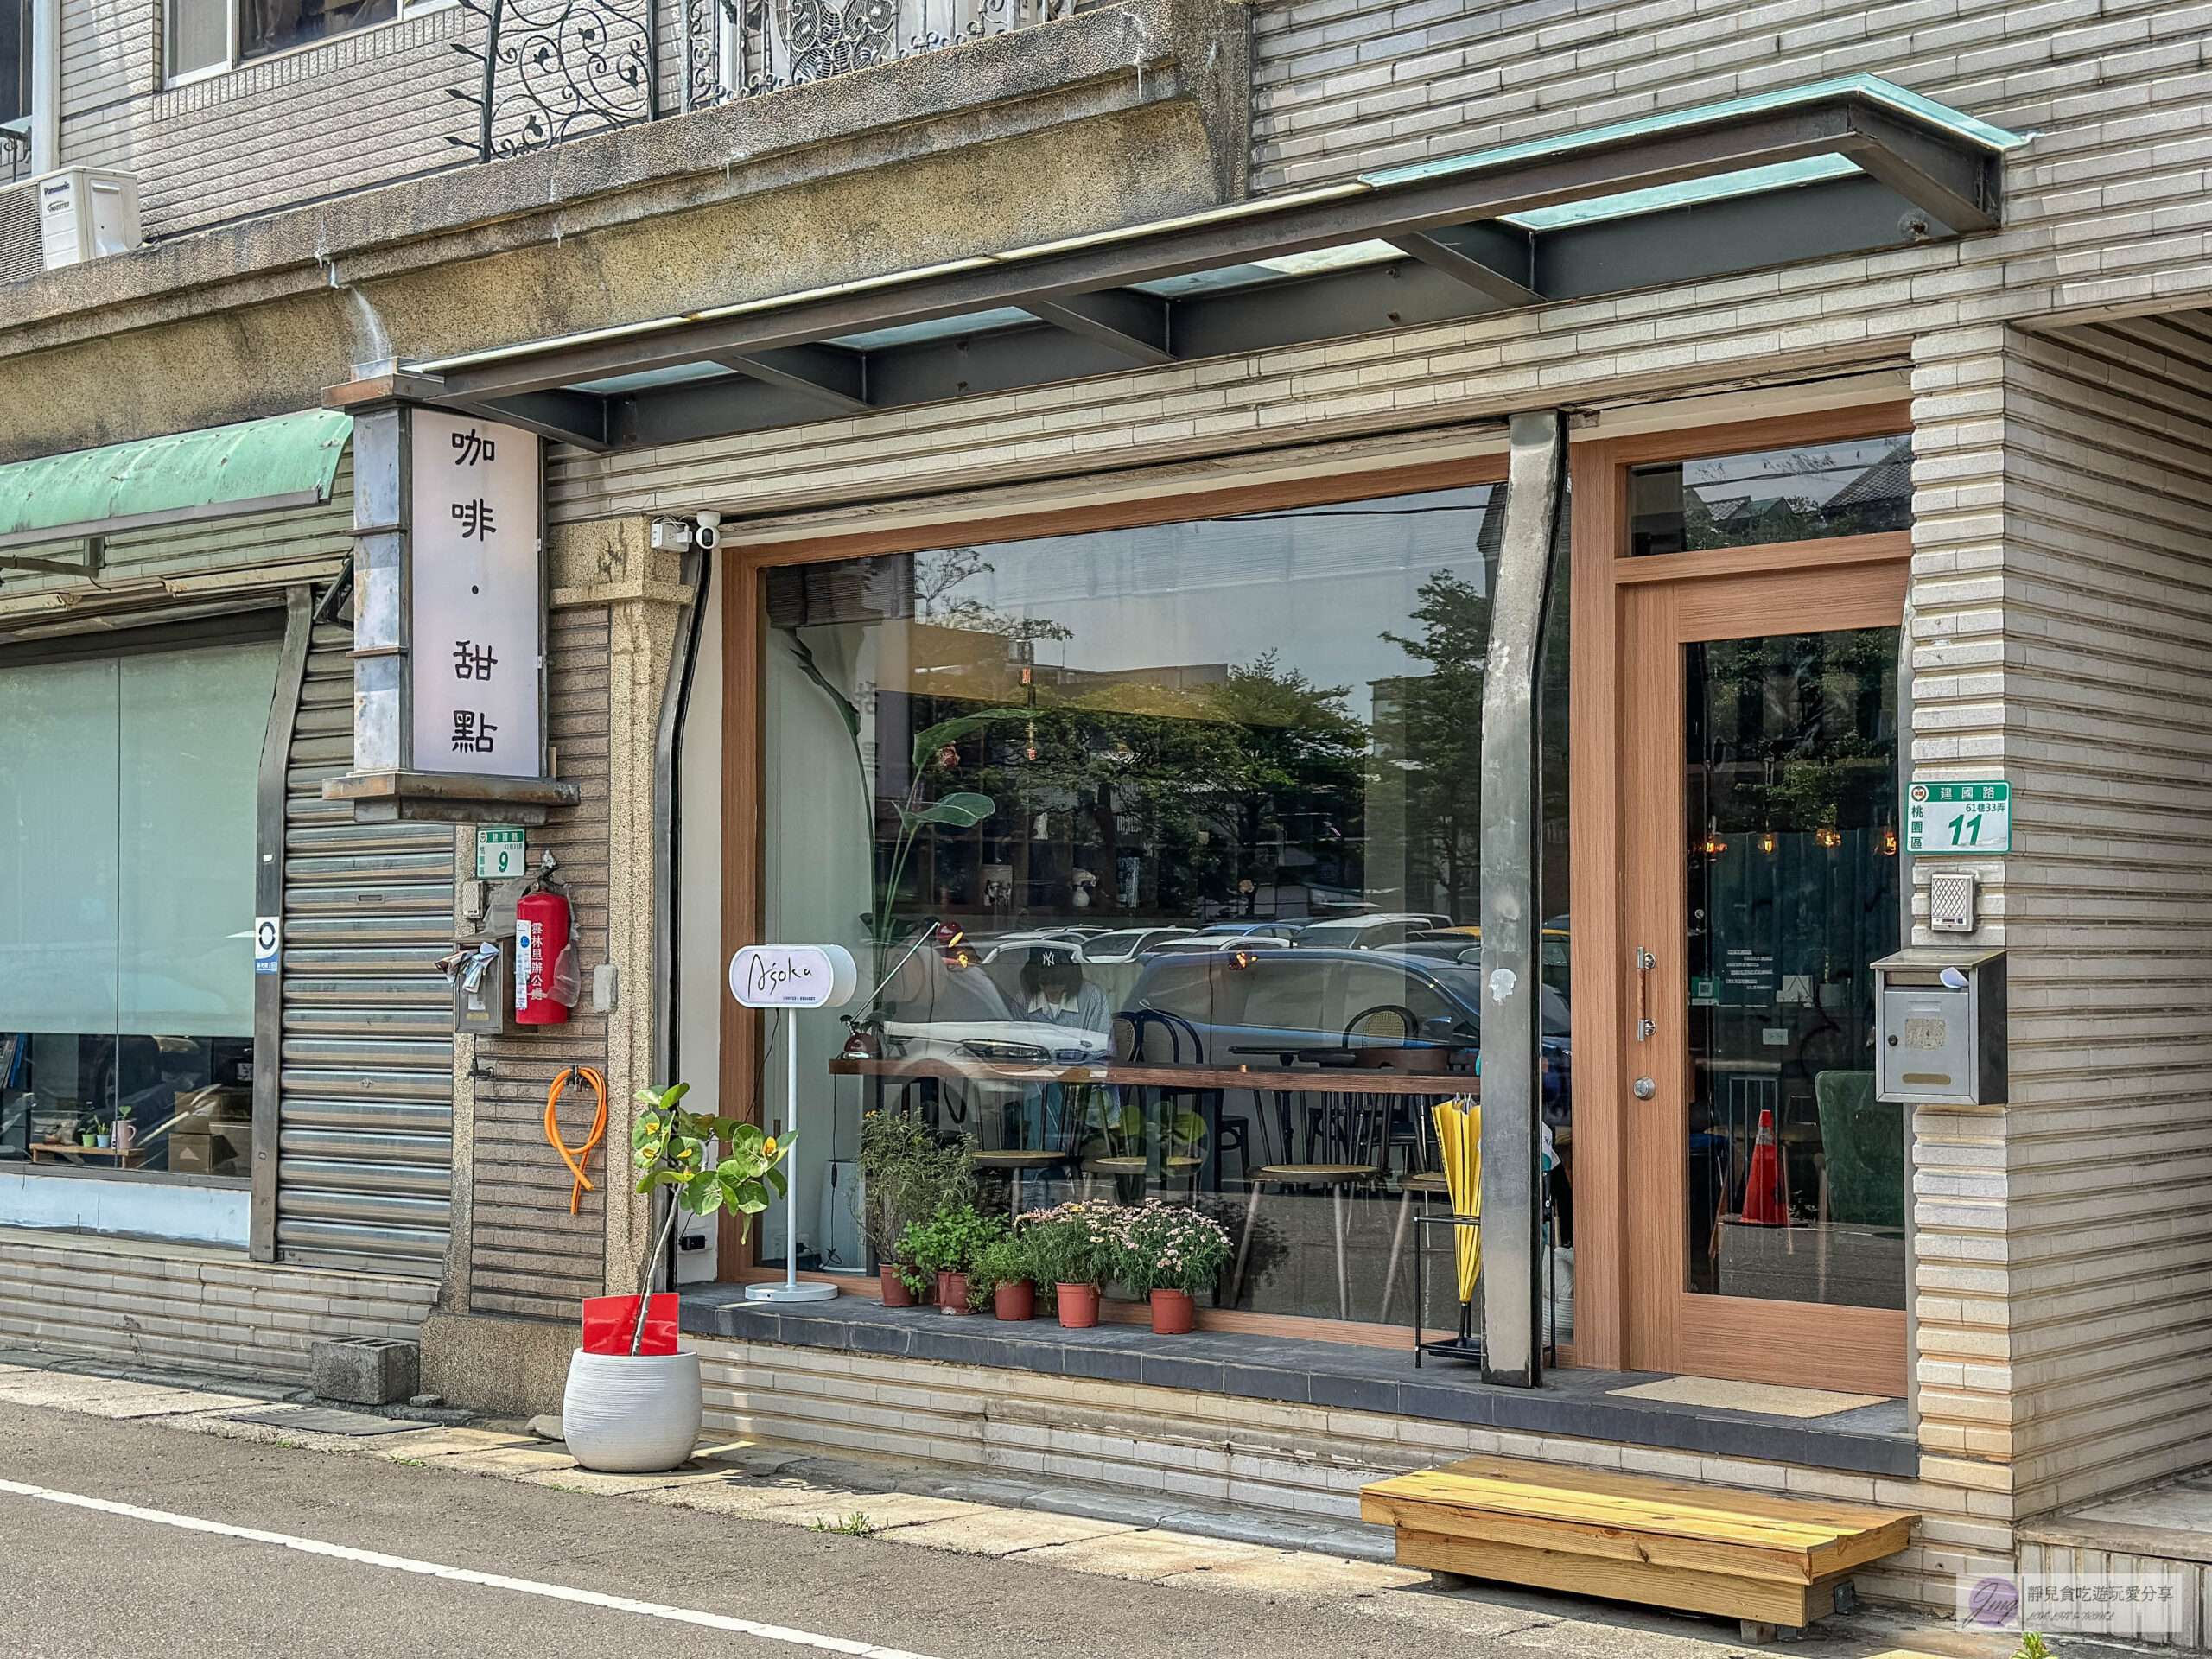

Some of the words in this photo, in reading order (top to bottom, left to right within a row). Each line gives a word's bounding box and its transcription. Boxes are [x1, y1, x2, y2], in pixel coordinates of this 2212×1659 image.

[1940, 786, 1995, 800] 建國路
[1966, 803, 2005, 812] 61巷33弄
[1911, 805, 1923, 849] 桃園區
[1948, 814, 1982, 846] 11
[499, 851, 508, 873] 9
[1042, 950, 1055, 967] NY
